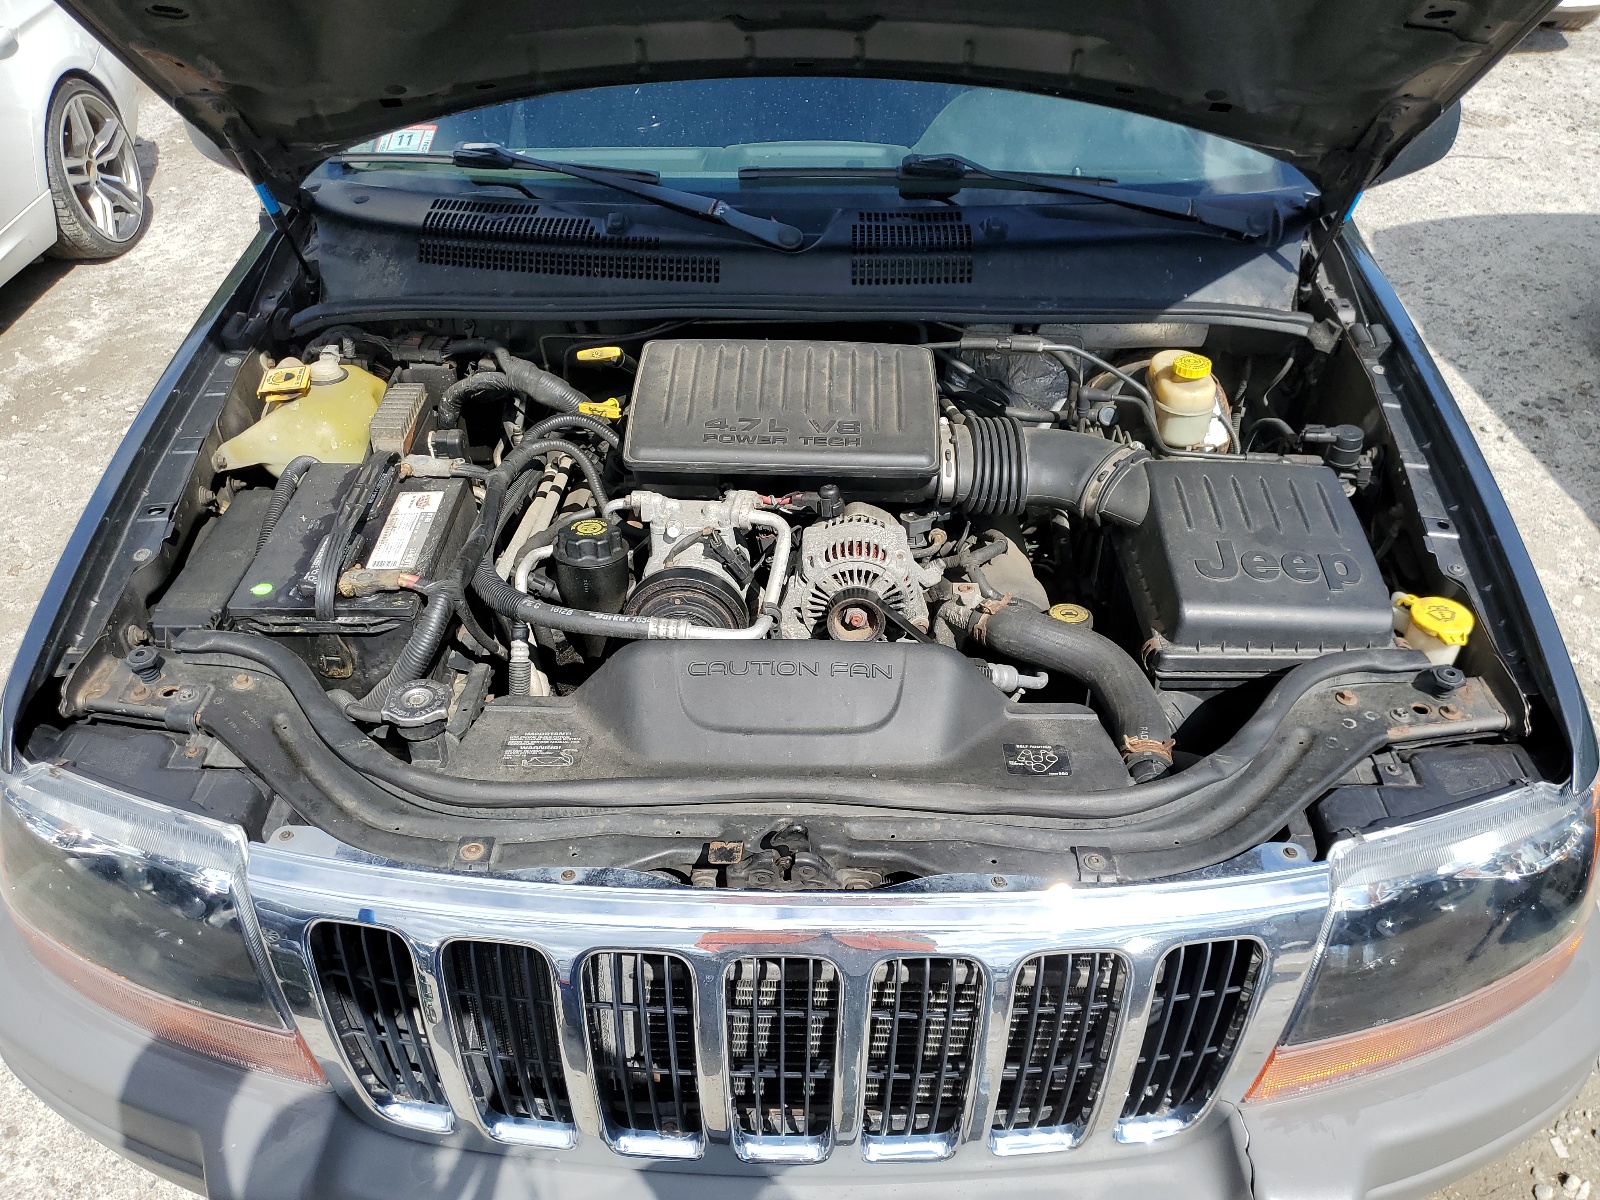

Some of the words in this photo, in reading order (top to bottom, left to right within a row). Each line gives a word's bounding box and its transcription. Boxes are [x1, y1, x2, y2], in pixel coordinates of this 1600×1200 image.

[398, 133, 413, 146] 11
[808, 419, 861, 435] V8
[702, 433, 788, 445] POWER
[799, 436, 862, 447] TECH
[1193, 539, 1362, 592] Jeep
[687, 660, 819, 677] CAUTION
[830, 661, 893, 679] FAN
